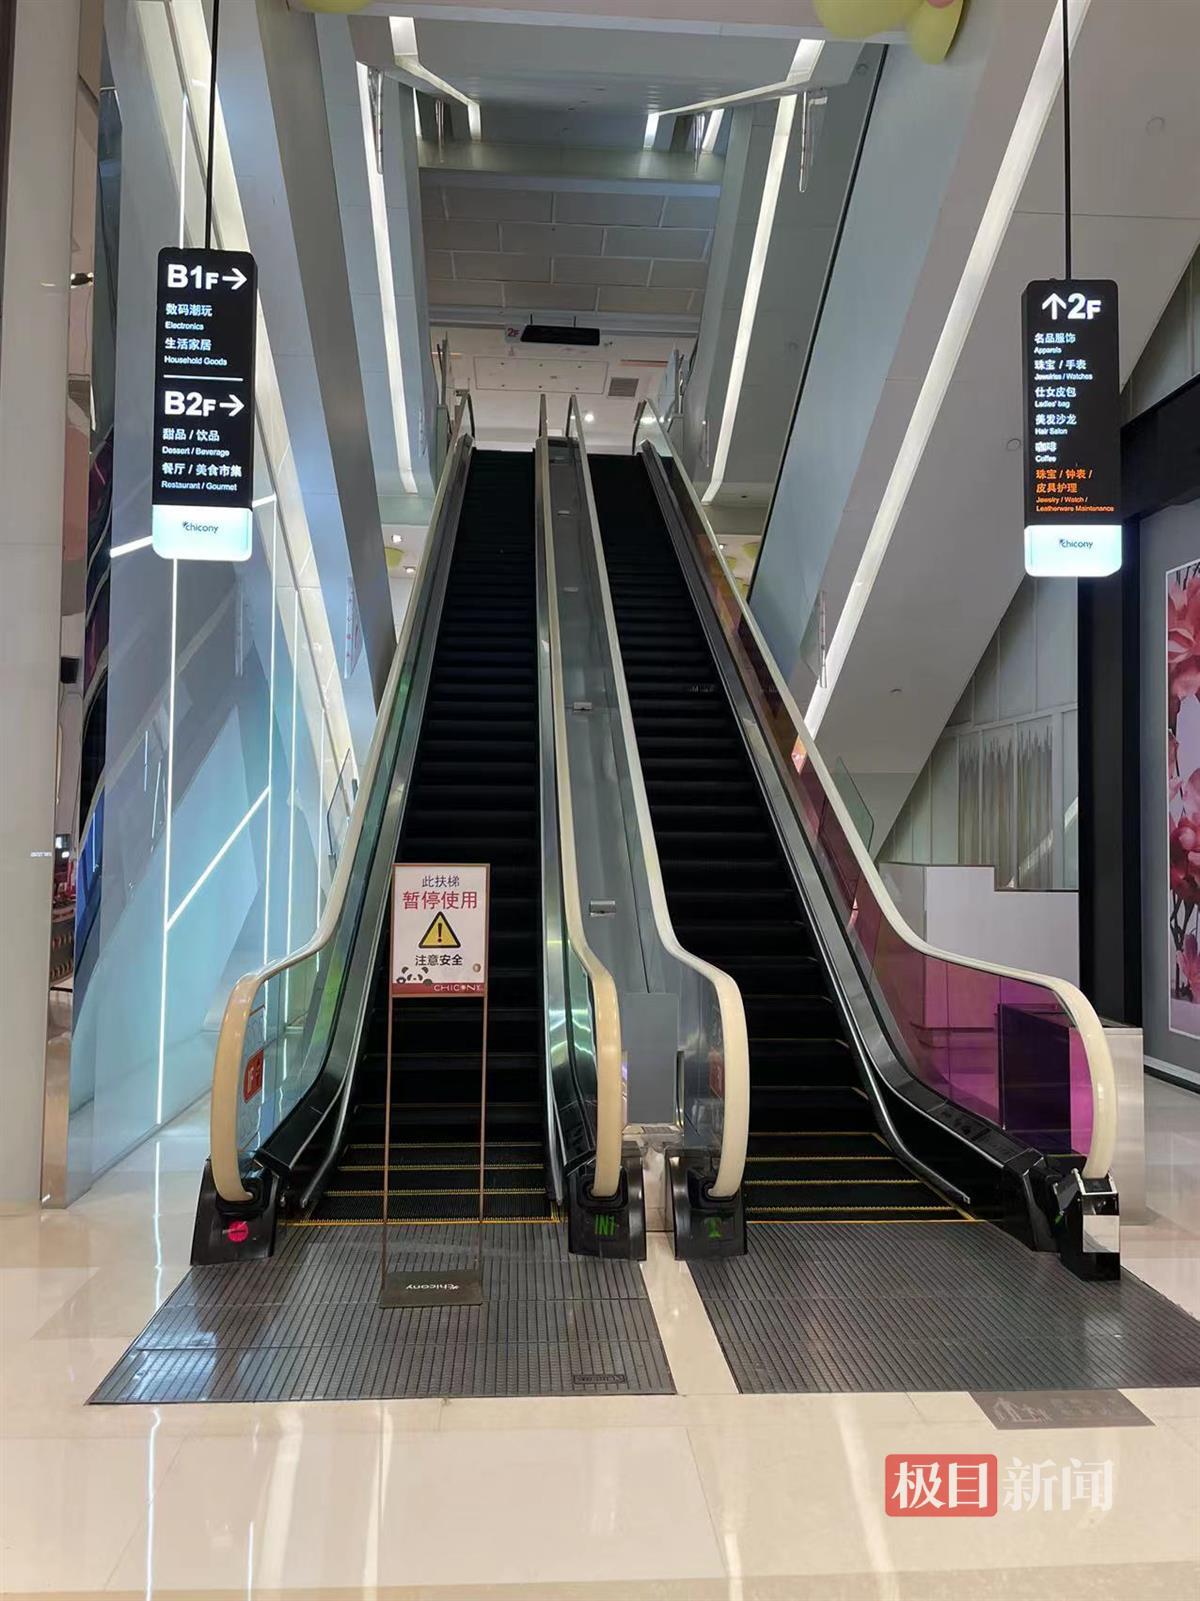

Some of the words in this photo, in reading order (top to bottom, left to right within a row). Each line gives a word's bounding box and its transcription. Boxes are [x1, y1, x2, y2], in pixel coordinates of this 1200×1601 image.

[168, 263, 219, 290] B1F
[165, 303, 213, 317] 数码潮玩
[1067, 293, 1102, 320] 2F
[164, 321, 205, 331] Electronics
[164, 337, 212, 351] 生活家居
[1034, 333, 1076, 344] 名品服饰
[164, 355, 203, 365] Household
[203, 356, 228, 366] Goods
[1034, 359, 1056, 370] 珠宝
[1065, 359, 1087, 371] 手表
[1065, 373, 1094, 381] Watches
[1035, 386, 1077, 398] 仕女皮包
[164, 391, 217, 417] B2F
[1035, 413, 1078, 426] 美发沙龙
[162, 428, 187, 441] 甜品
[196, 429, 220, 442] 饮品
[1035, 427, 1049, 435] Hair
[1049, 427, 1068, 435] Salon
[161, 446, 190, 456] Dessert
[195, 448, 230, 458] Beverage
[161, 462, 186, 475] 餐厅
[196, 463, 242, 478] 美食市集
[1036, 469, 1057, 480] 珠宝
[1065, 469, 1087, 480] 钟表
[160, 481, 201, 490] Restaurant
[205, 482, 238, 491] Gourmet
[1036, 483, 1078, 494] 皮具护理
[1064, 496, 1085, 504] Watch
[184, 522, 219, 534] chicony
[1060, 538, 1093, 549] chicony
[421, 875, 460, 888] 此扶梯
[403, 891, 478, 910] 暂停使用
[415, 954, 463, 967] 注意安全
